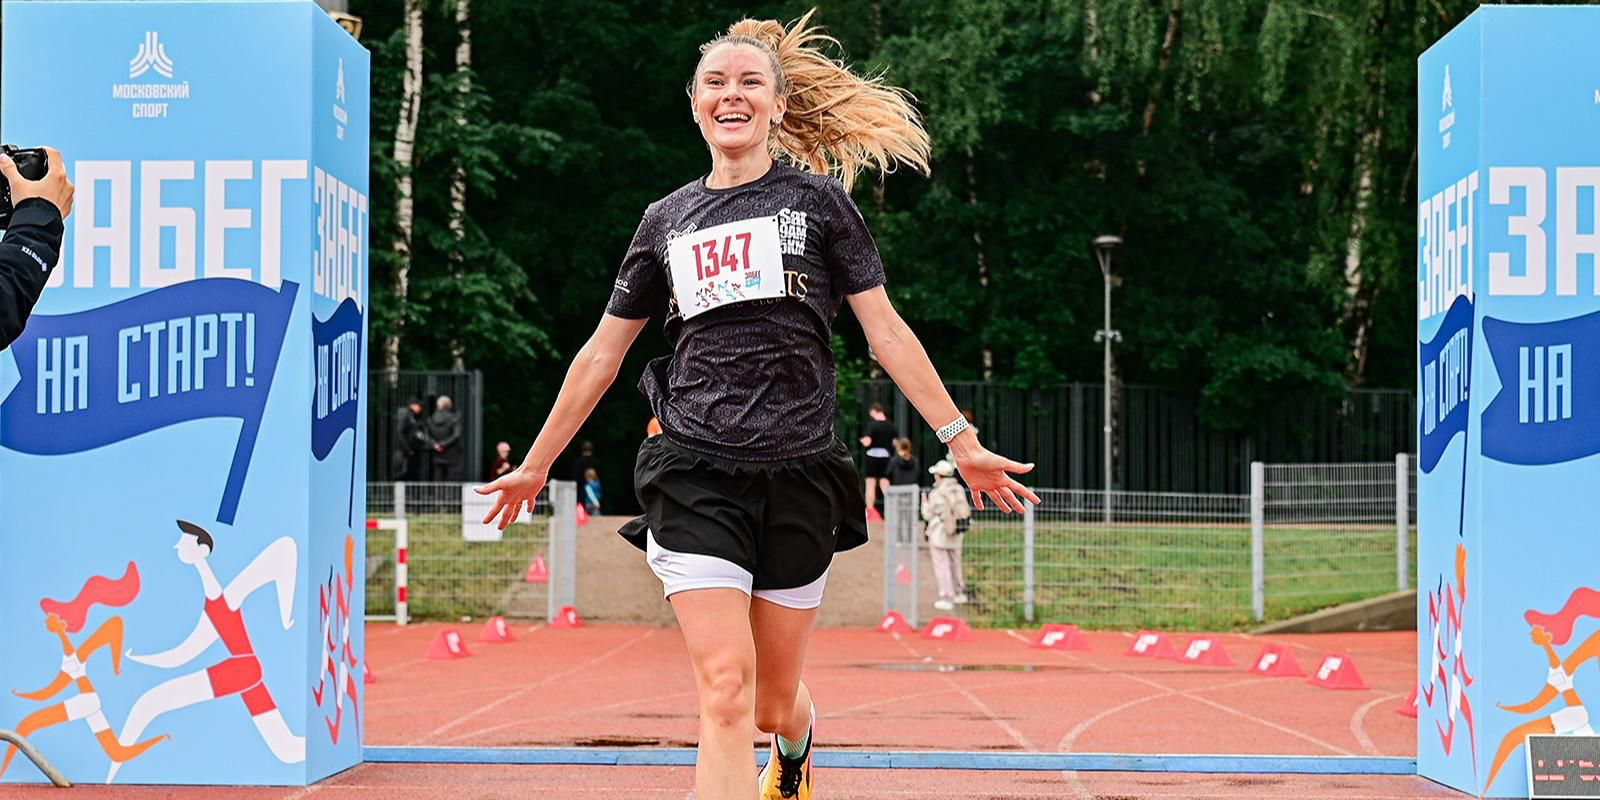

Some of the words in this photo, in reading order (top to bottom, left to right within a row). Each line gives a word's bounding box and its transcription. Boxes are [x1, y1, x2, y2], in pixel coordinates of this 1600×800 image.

[112, 81, 190, 99] МОСКОВСКИЙ
[132, 103, 169, 118] СПОРТ
[45, 160, 308, 288] АБЕГ
[314, 166, 367, 314] ЗАБЕГ
[692, 232, 752, 281] 1347
[1419, 169, 1479, 321] ЗАБЕГ
[37, 335, 90, 415] НА
[118, 312, 256, 403] СТАРТ!
[1519, 343, 1573, 424] НА
